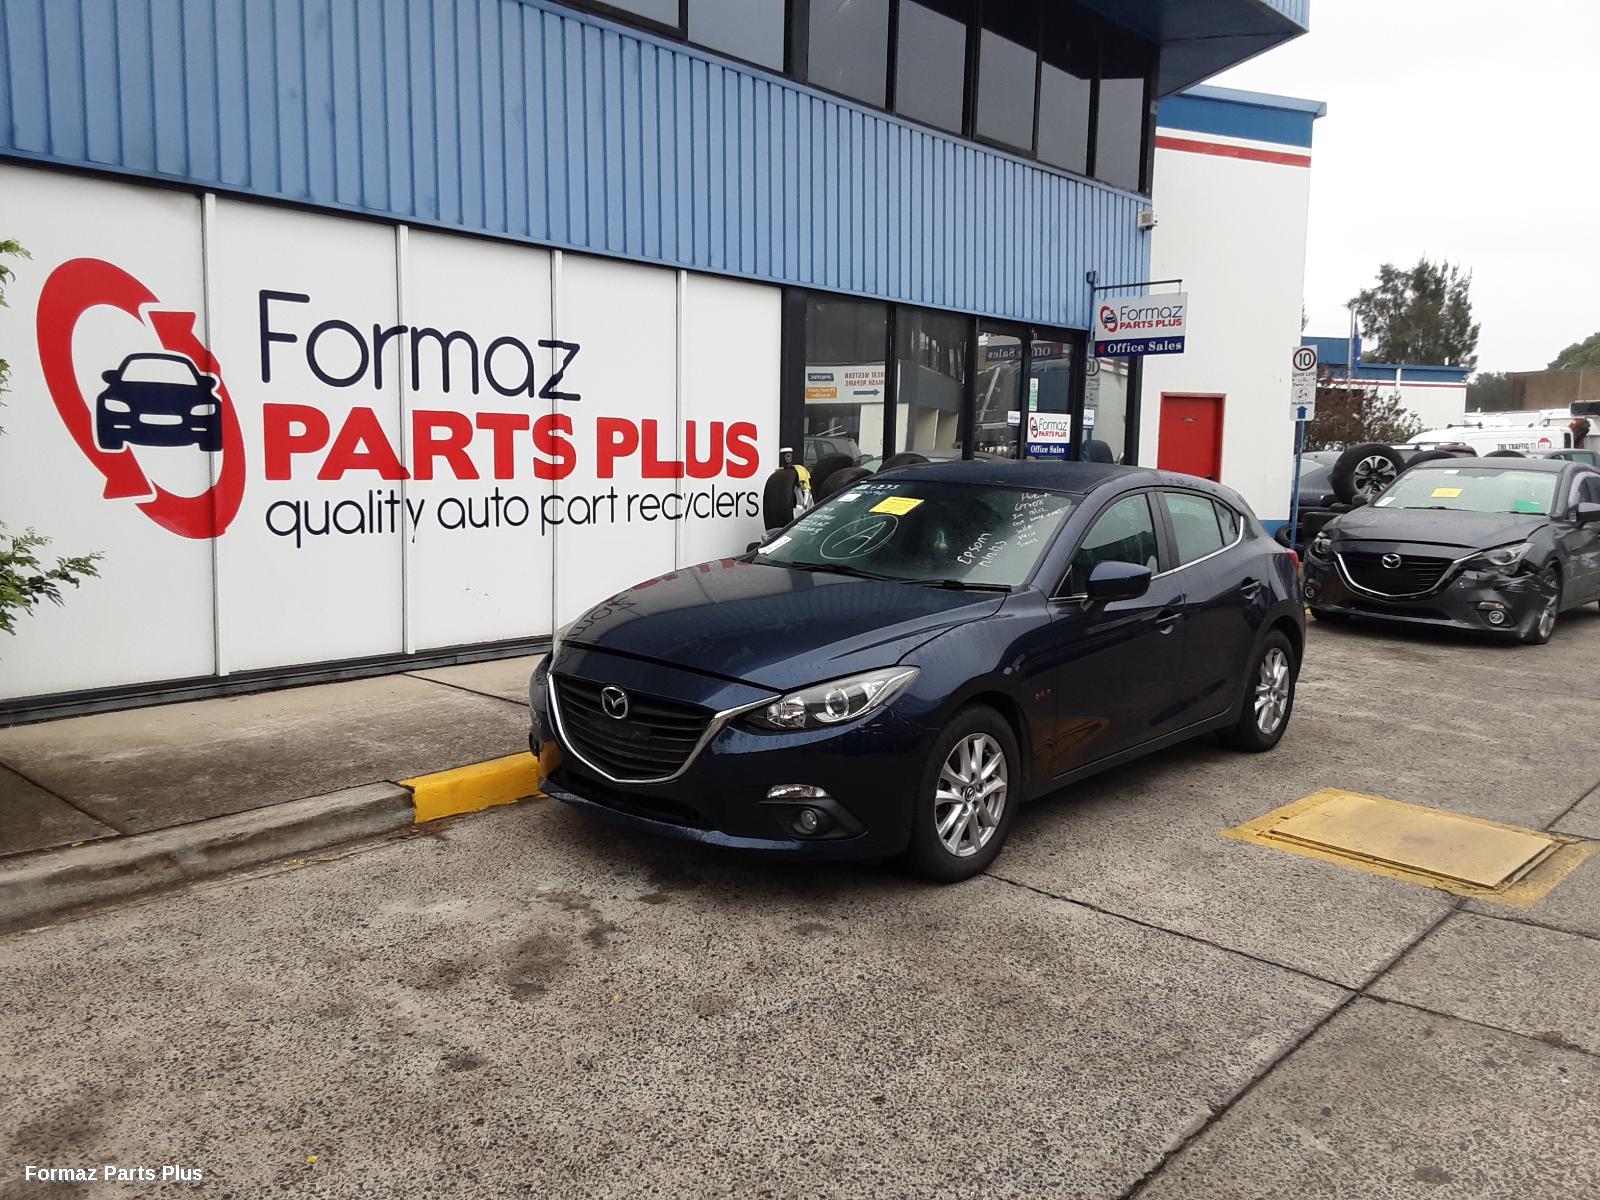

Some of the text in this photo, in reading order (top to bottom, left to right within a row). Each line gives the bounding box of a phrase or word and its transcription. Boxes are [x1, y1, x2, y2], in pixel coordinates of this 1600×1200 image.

[1120, 305, 1183, 321] Formaz
[1120, 318, 1182, 330] PARTS PLUS
[259, 290, 581, 401] Formaz
[1107, 340, 1182, 354] Office Sales
[1299, 353, 1311, 366] 10
[1039, 418, 1067, 431] Formaz
[263, 403, 760, 480] PARTS PLUS
[1497, 443, 1507, 451] THE
[1508, 442, 1529, 450] TRAFFIC
[1030, 445, 1048, 453] Office
[265, 484, 759, 548] quality auto part recyclers
